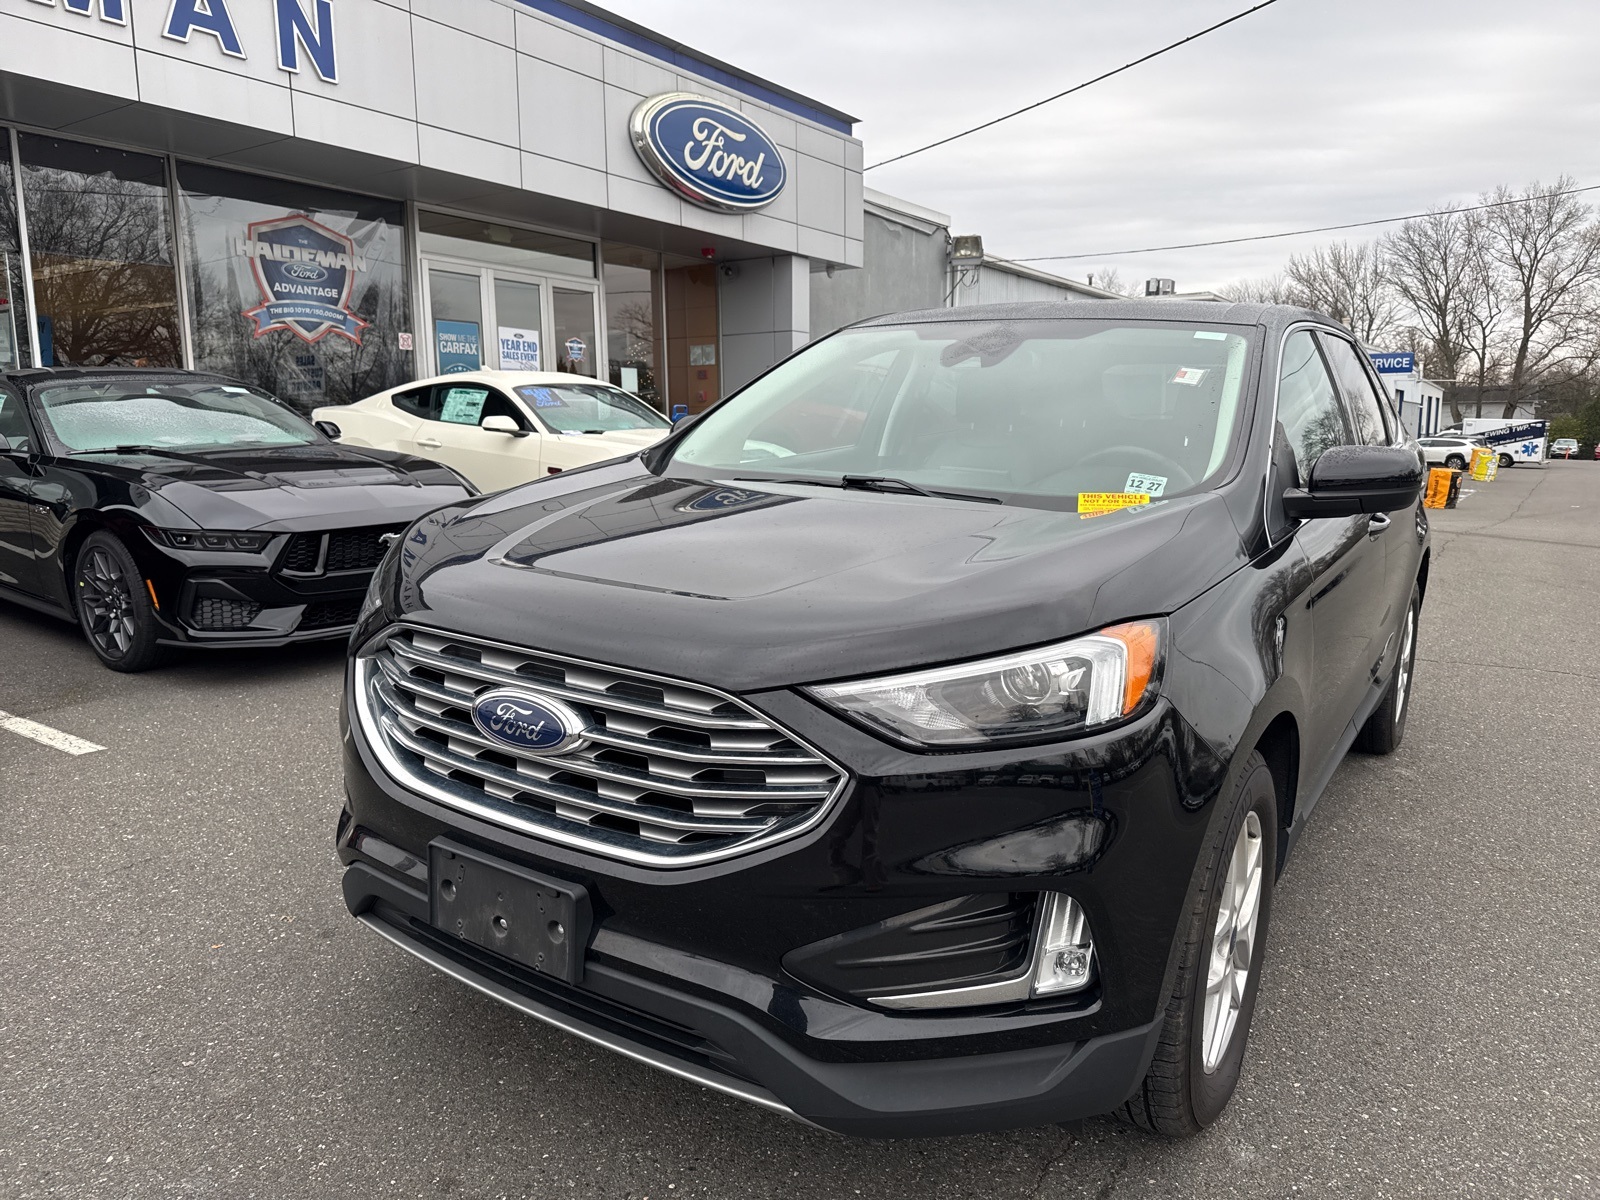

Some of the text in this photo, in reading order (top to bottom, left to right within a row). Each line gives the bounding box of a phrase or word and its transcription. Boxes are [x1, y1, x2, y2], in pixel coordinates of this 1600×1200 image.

[684, 117, 766, 189] Ford
[290, 264, 319, 280] Ford
[273, 282, 339, 298] ADVANTAGE
[439, 333, 477, 343] SHOW ME THE
[440, 341, 478, 355] CARFAX
[500, 339, 538, 353] YEAR END
[502, 351, 538, 362] SALES EVENT
[1484, 428, 1510, 437] EWING
[1129, 479, 1144, 488] 12
[1147, 482, 1162, 492] 27
[490, 702, 546, 742] Ford
